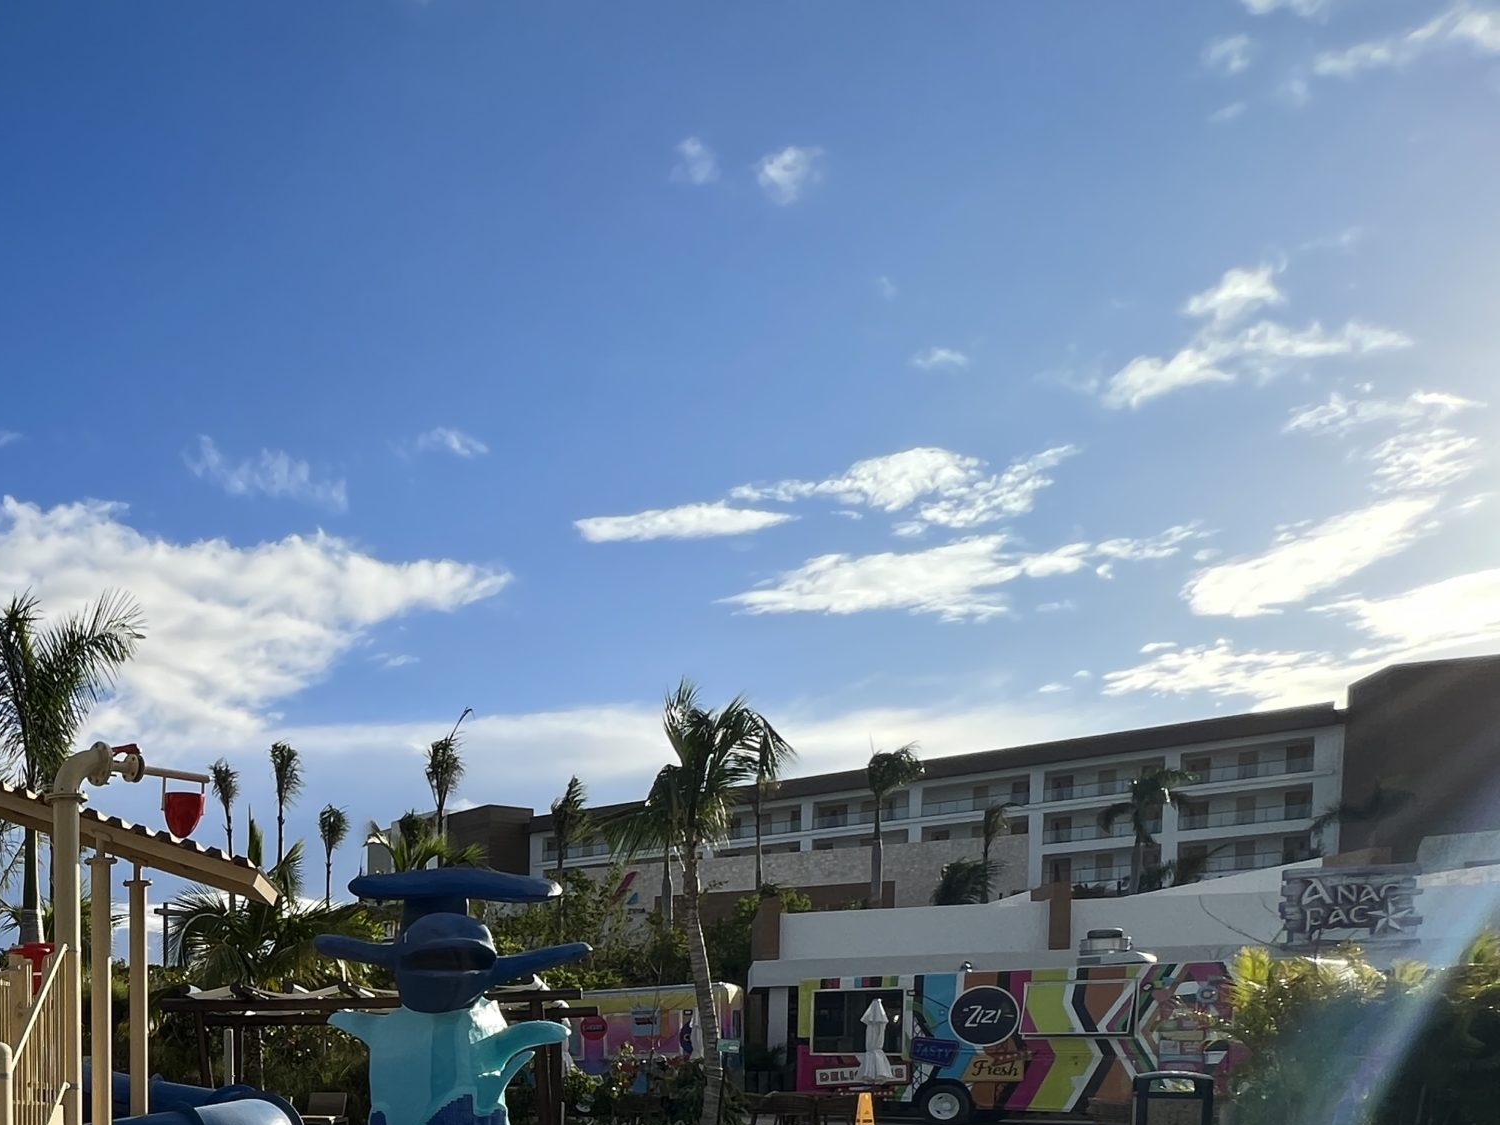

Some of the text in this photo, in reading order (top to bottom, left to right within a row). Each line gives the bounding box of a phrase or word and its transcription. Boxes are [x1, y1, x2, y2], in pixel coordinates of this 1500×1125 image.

[915, 1042, 954, 1058] TASTY
[818, 1067, 905, 1083] DELIS
[971, 1059, 1019, 1077] Fresh
